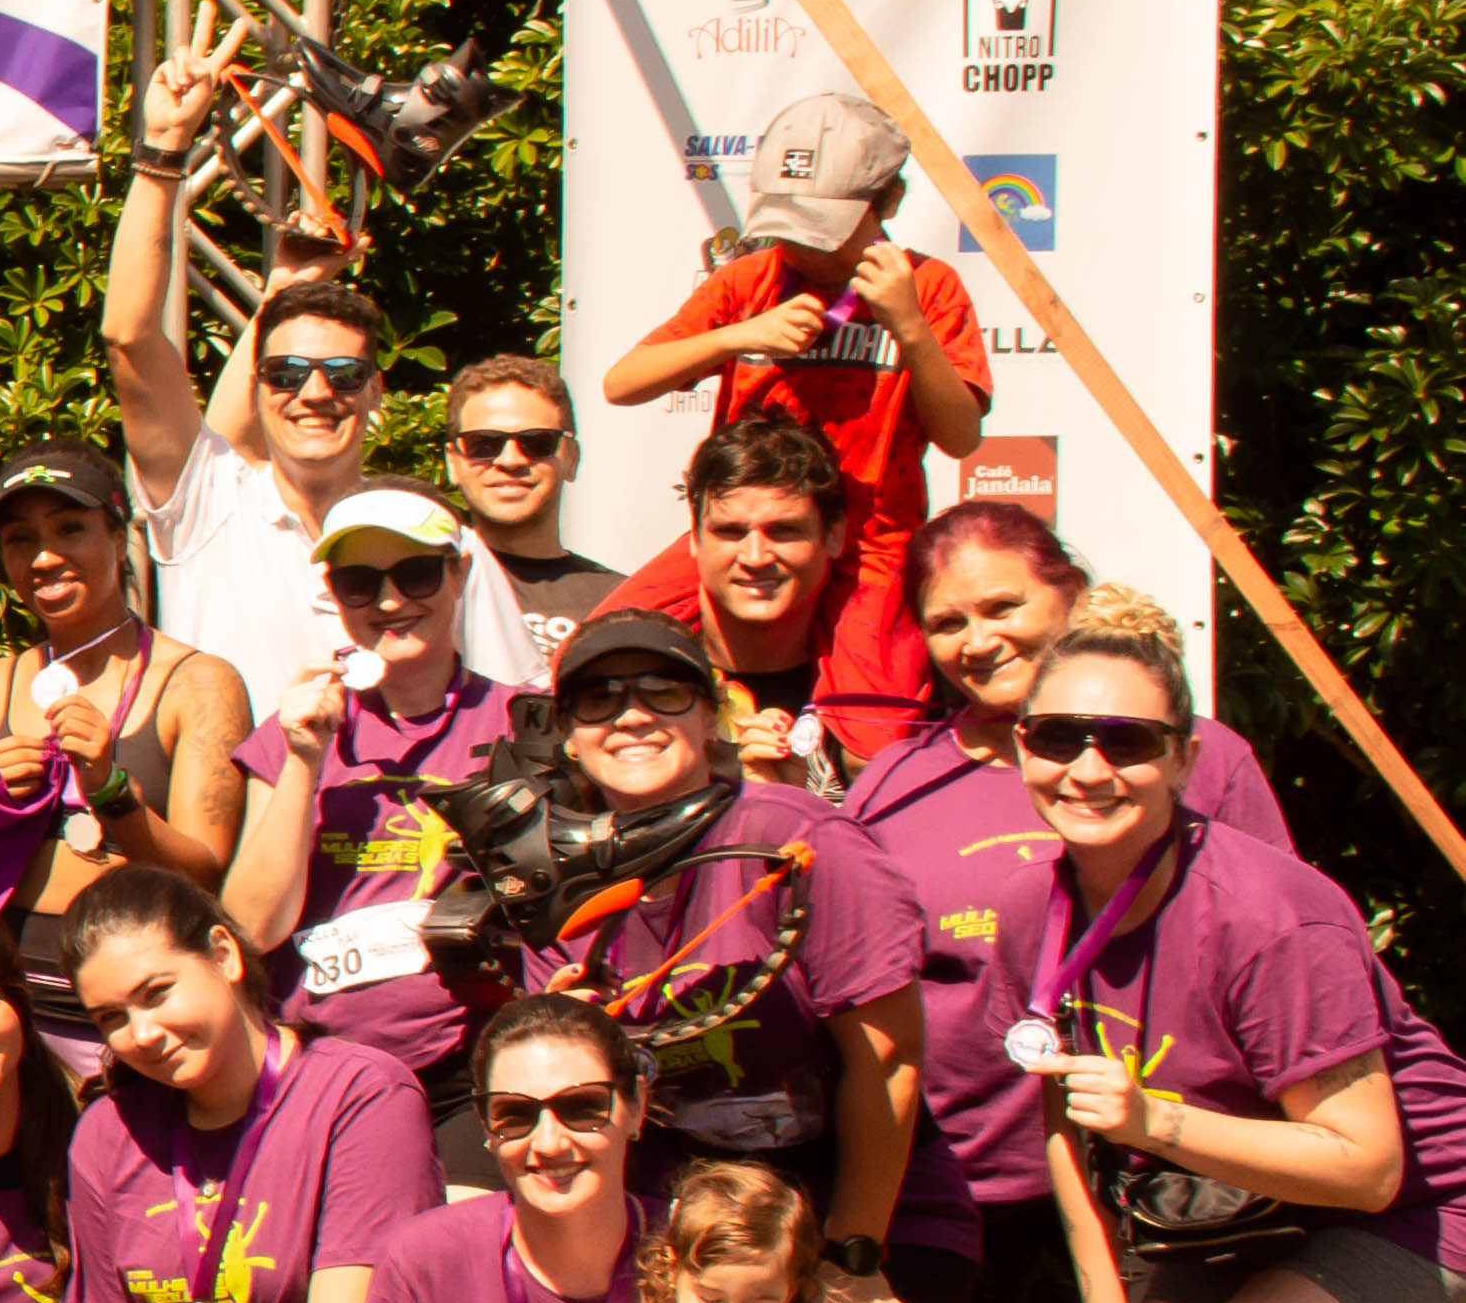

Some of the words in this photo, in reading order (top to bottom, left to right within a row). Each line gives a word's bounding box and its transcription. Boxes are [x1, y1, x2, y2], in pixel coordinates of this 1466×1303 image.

[978, 36, 1041, 59] NITRO
[963, 64, 1054, 92] CHOPP
[974, 465, 1013, 479] Café
[964, 475, 1053, 500] Jandaia
